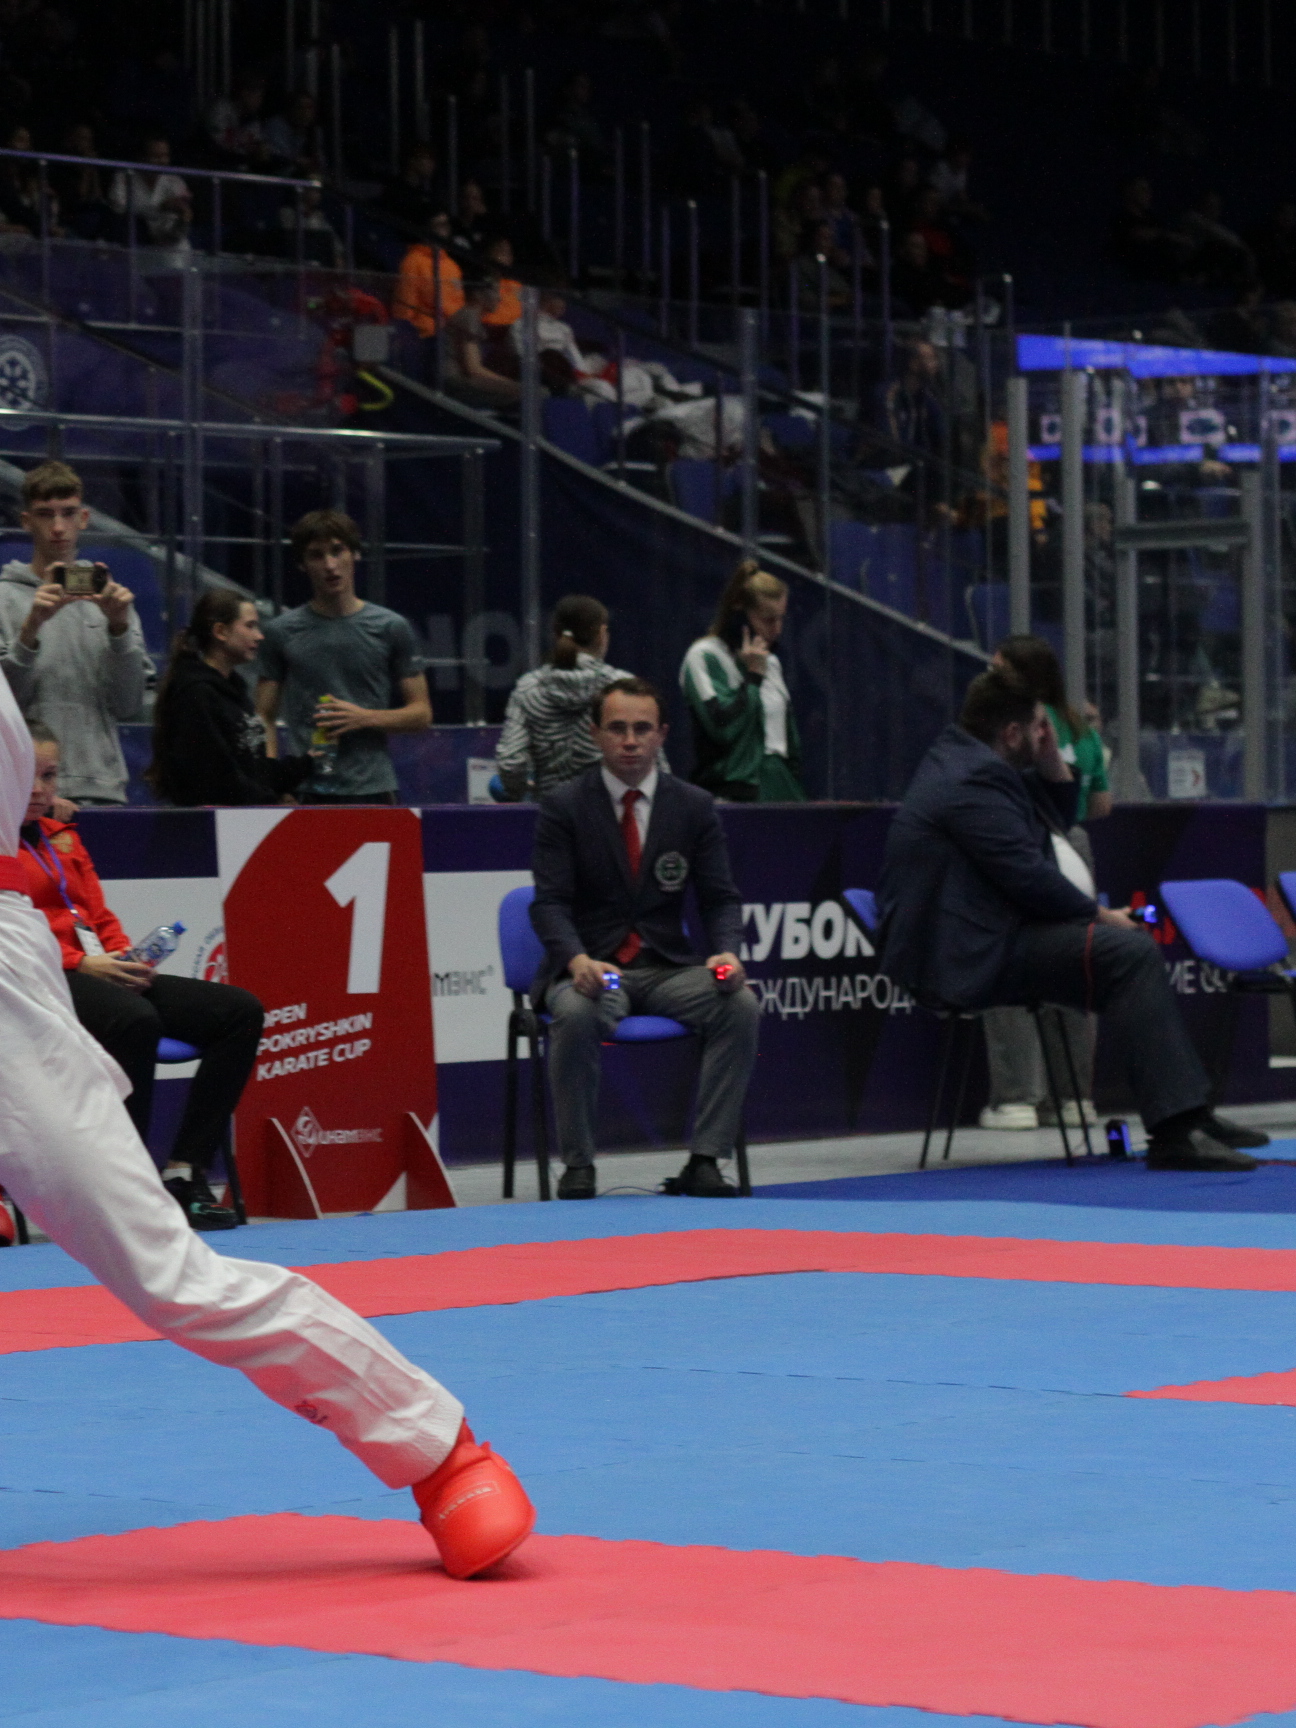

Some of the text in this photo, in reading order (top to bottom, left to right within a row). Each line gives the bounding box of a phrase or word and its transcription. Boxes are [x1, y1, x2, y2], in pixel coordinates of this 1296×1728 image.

[323, 842, 391, 994] 1
[256, 1012, 373, 1056] POKRYSHKIN
[256, 1039, 372, 1081] KARATE CUP
